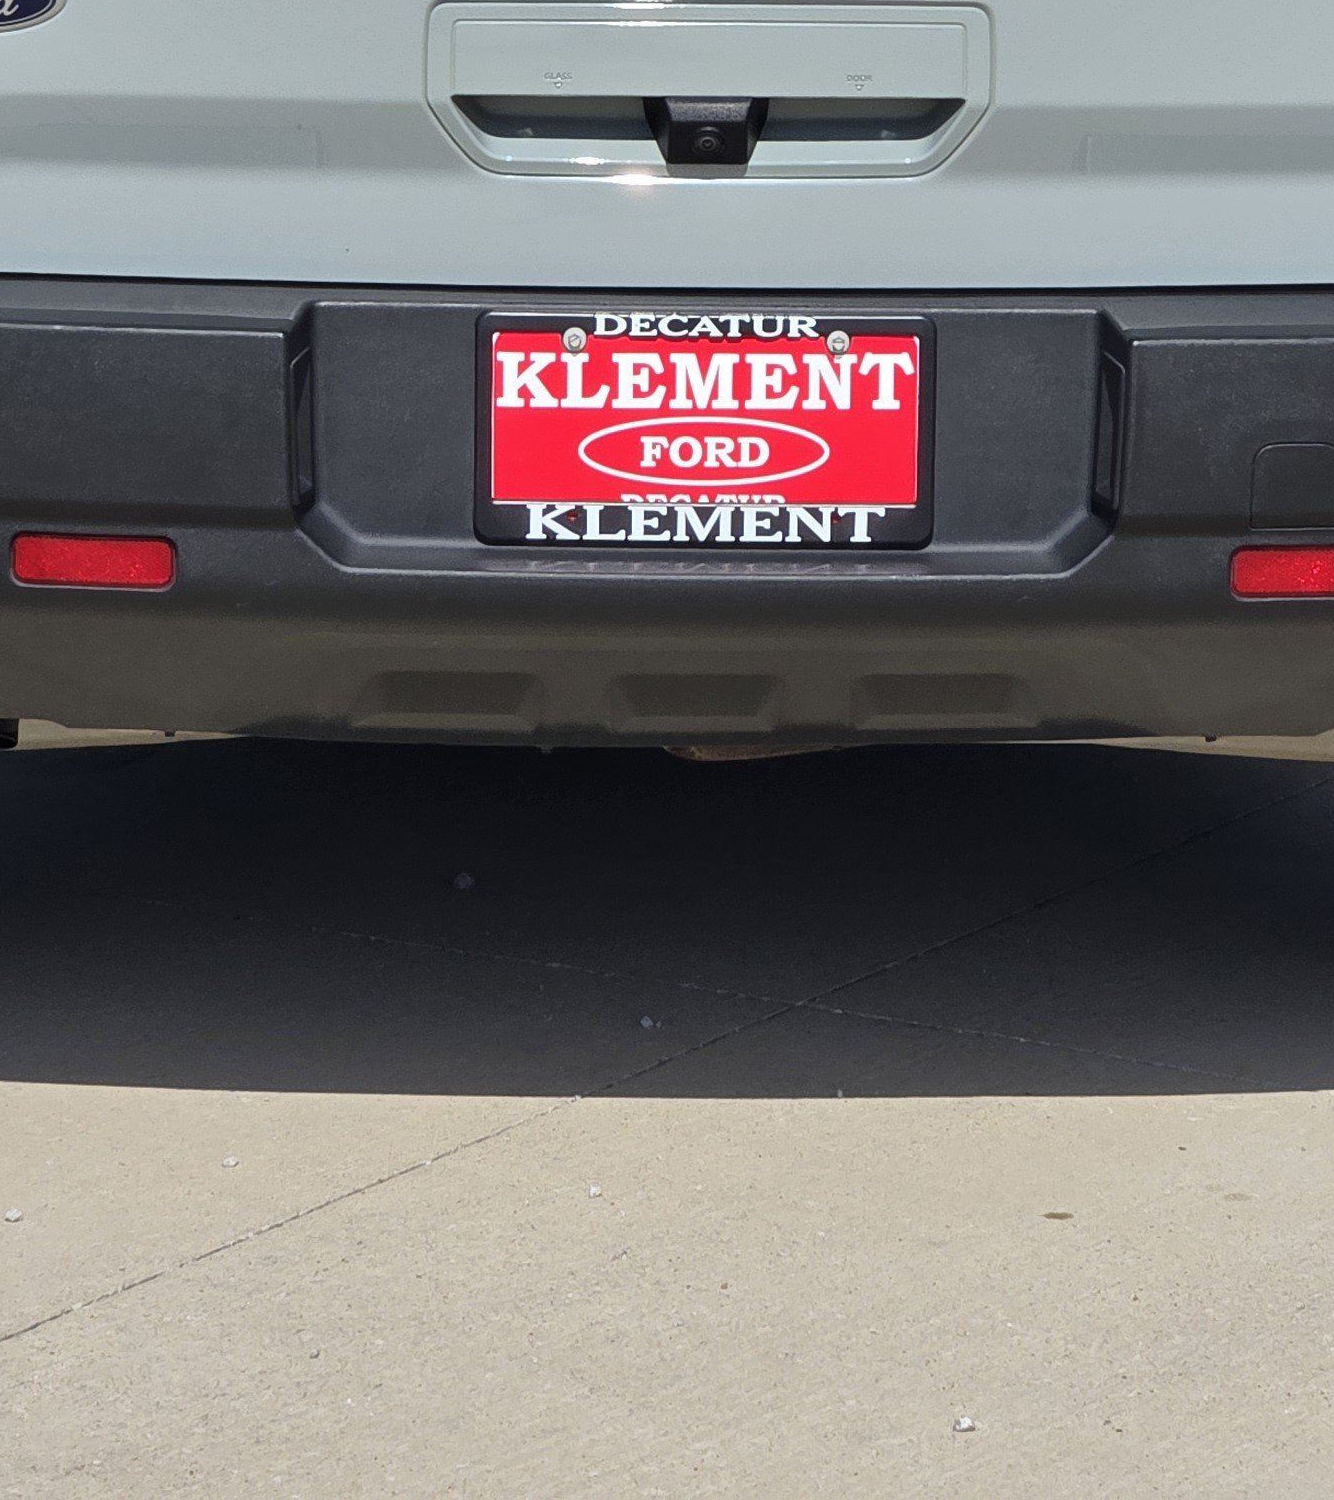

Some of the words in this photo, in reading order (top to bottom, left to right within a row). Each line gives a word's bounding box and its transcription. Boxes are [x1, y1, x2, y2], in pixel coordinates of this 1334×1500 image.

[594, 313, 819, 338] DECATUR
[496, 351, 915, 410] KLEMENT
[640, 436, 770, 468] FORD
[525, 503, 886, 543] KLEMENT
